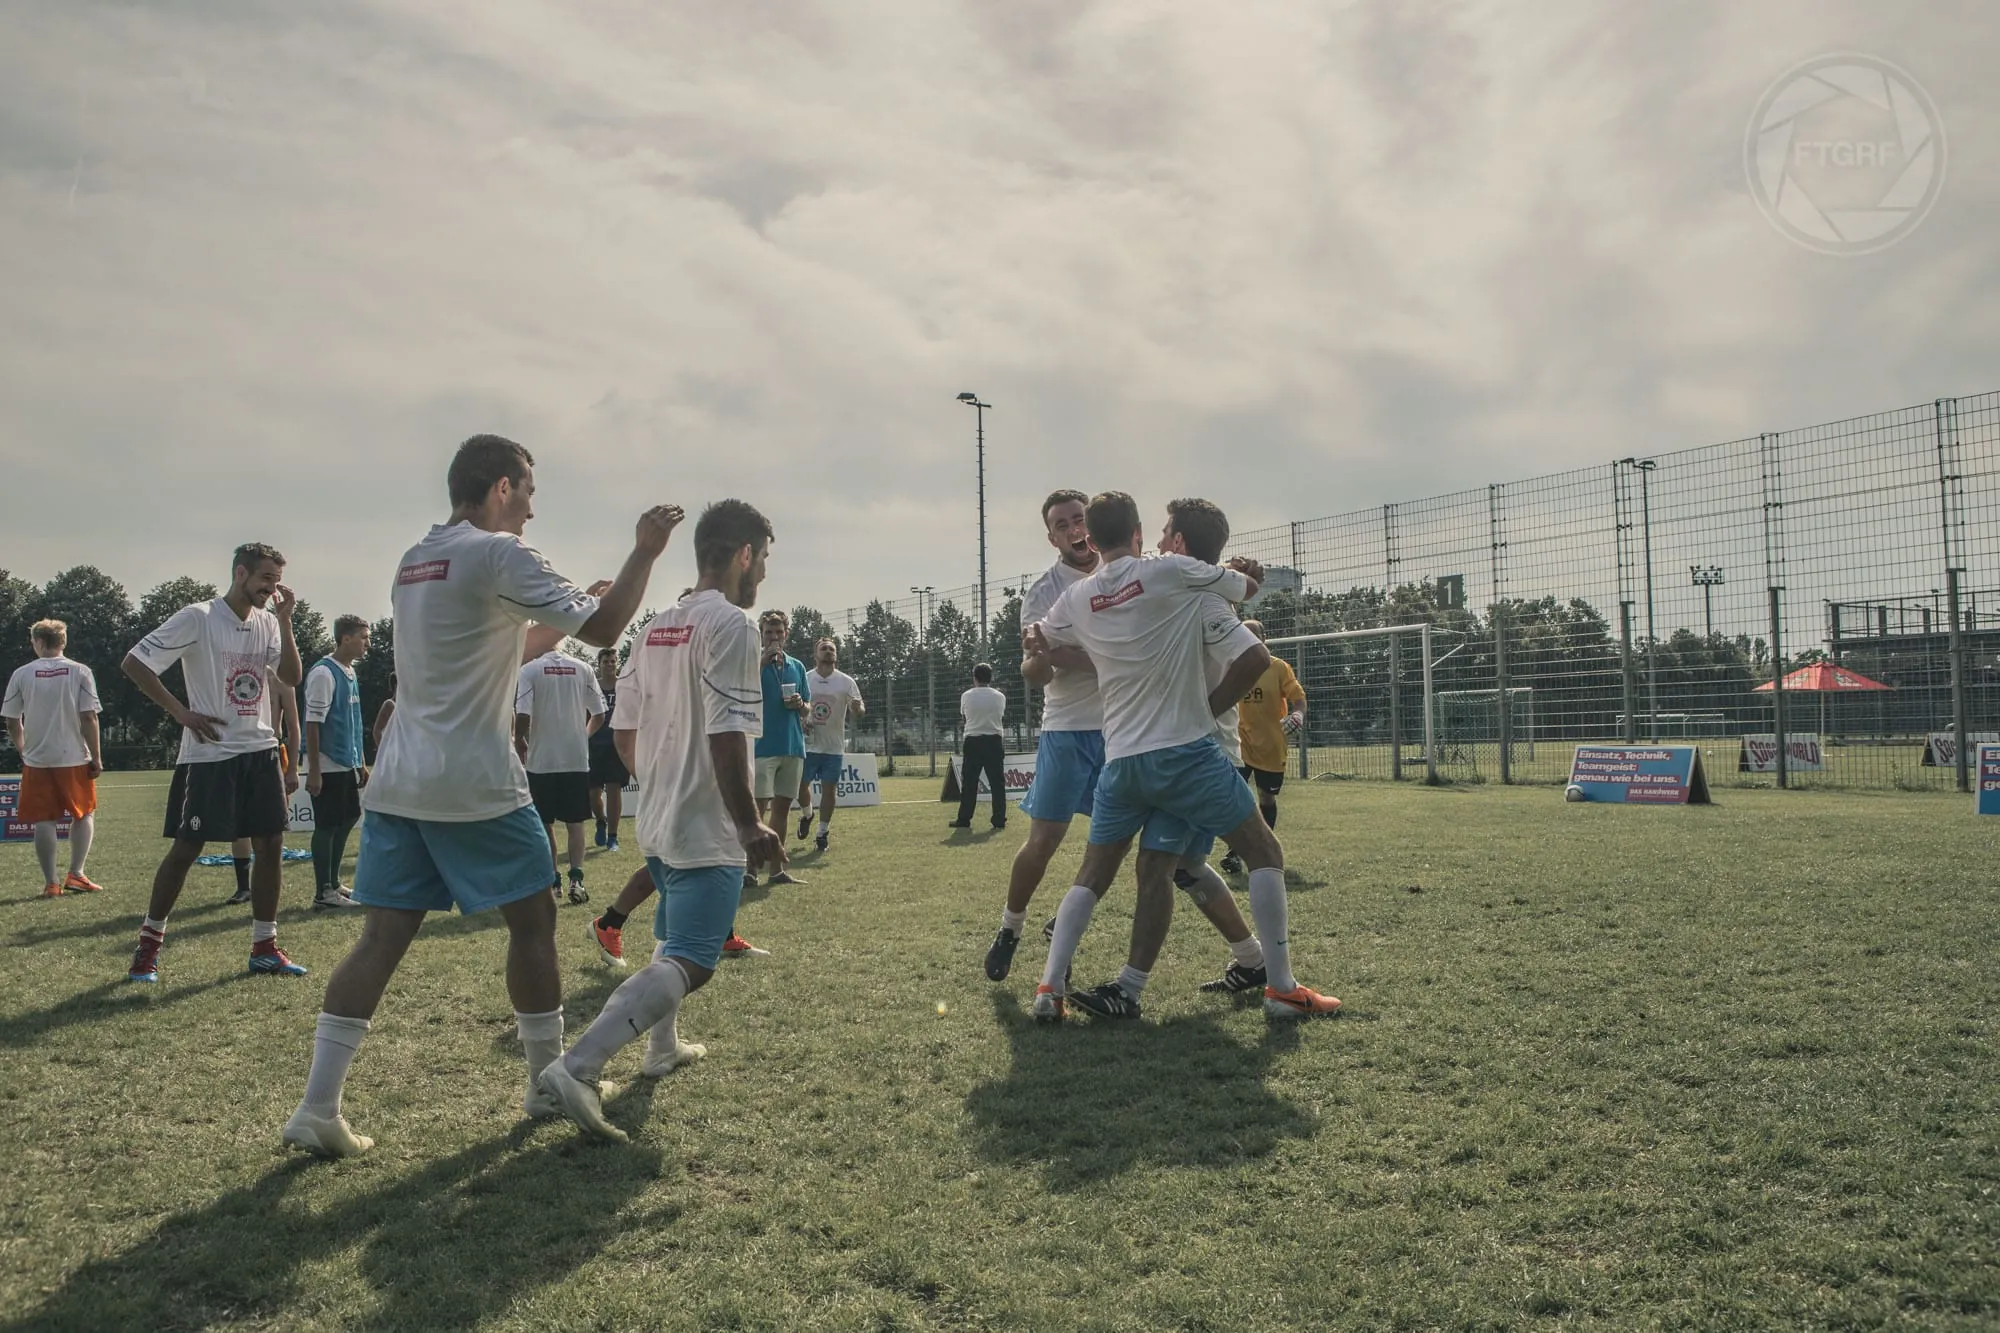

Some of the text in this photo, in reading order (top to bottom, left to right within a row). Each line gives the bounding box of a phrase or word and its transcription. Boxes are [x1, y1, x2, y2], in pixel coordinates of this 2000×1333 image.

[1443, 580, 1452, 605] 1
[1578, 750, 1671, 761] Einsatz, Technik,
[1577, 761, 1637, 772] Teamgeist:
[1574, 774, 1678, 783] genau wie bei uns.
